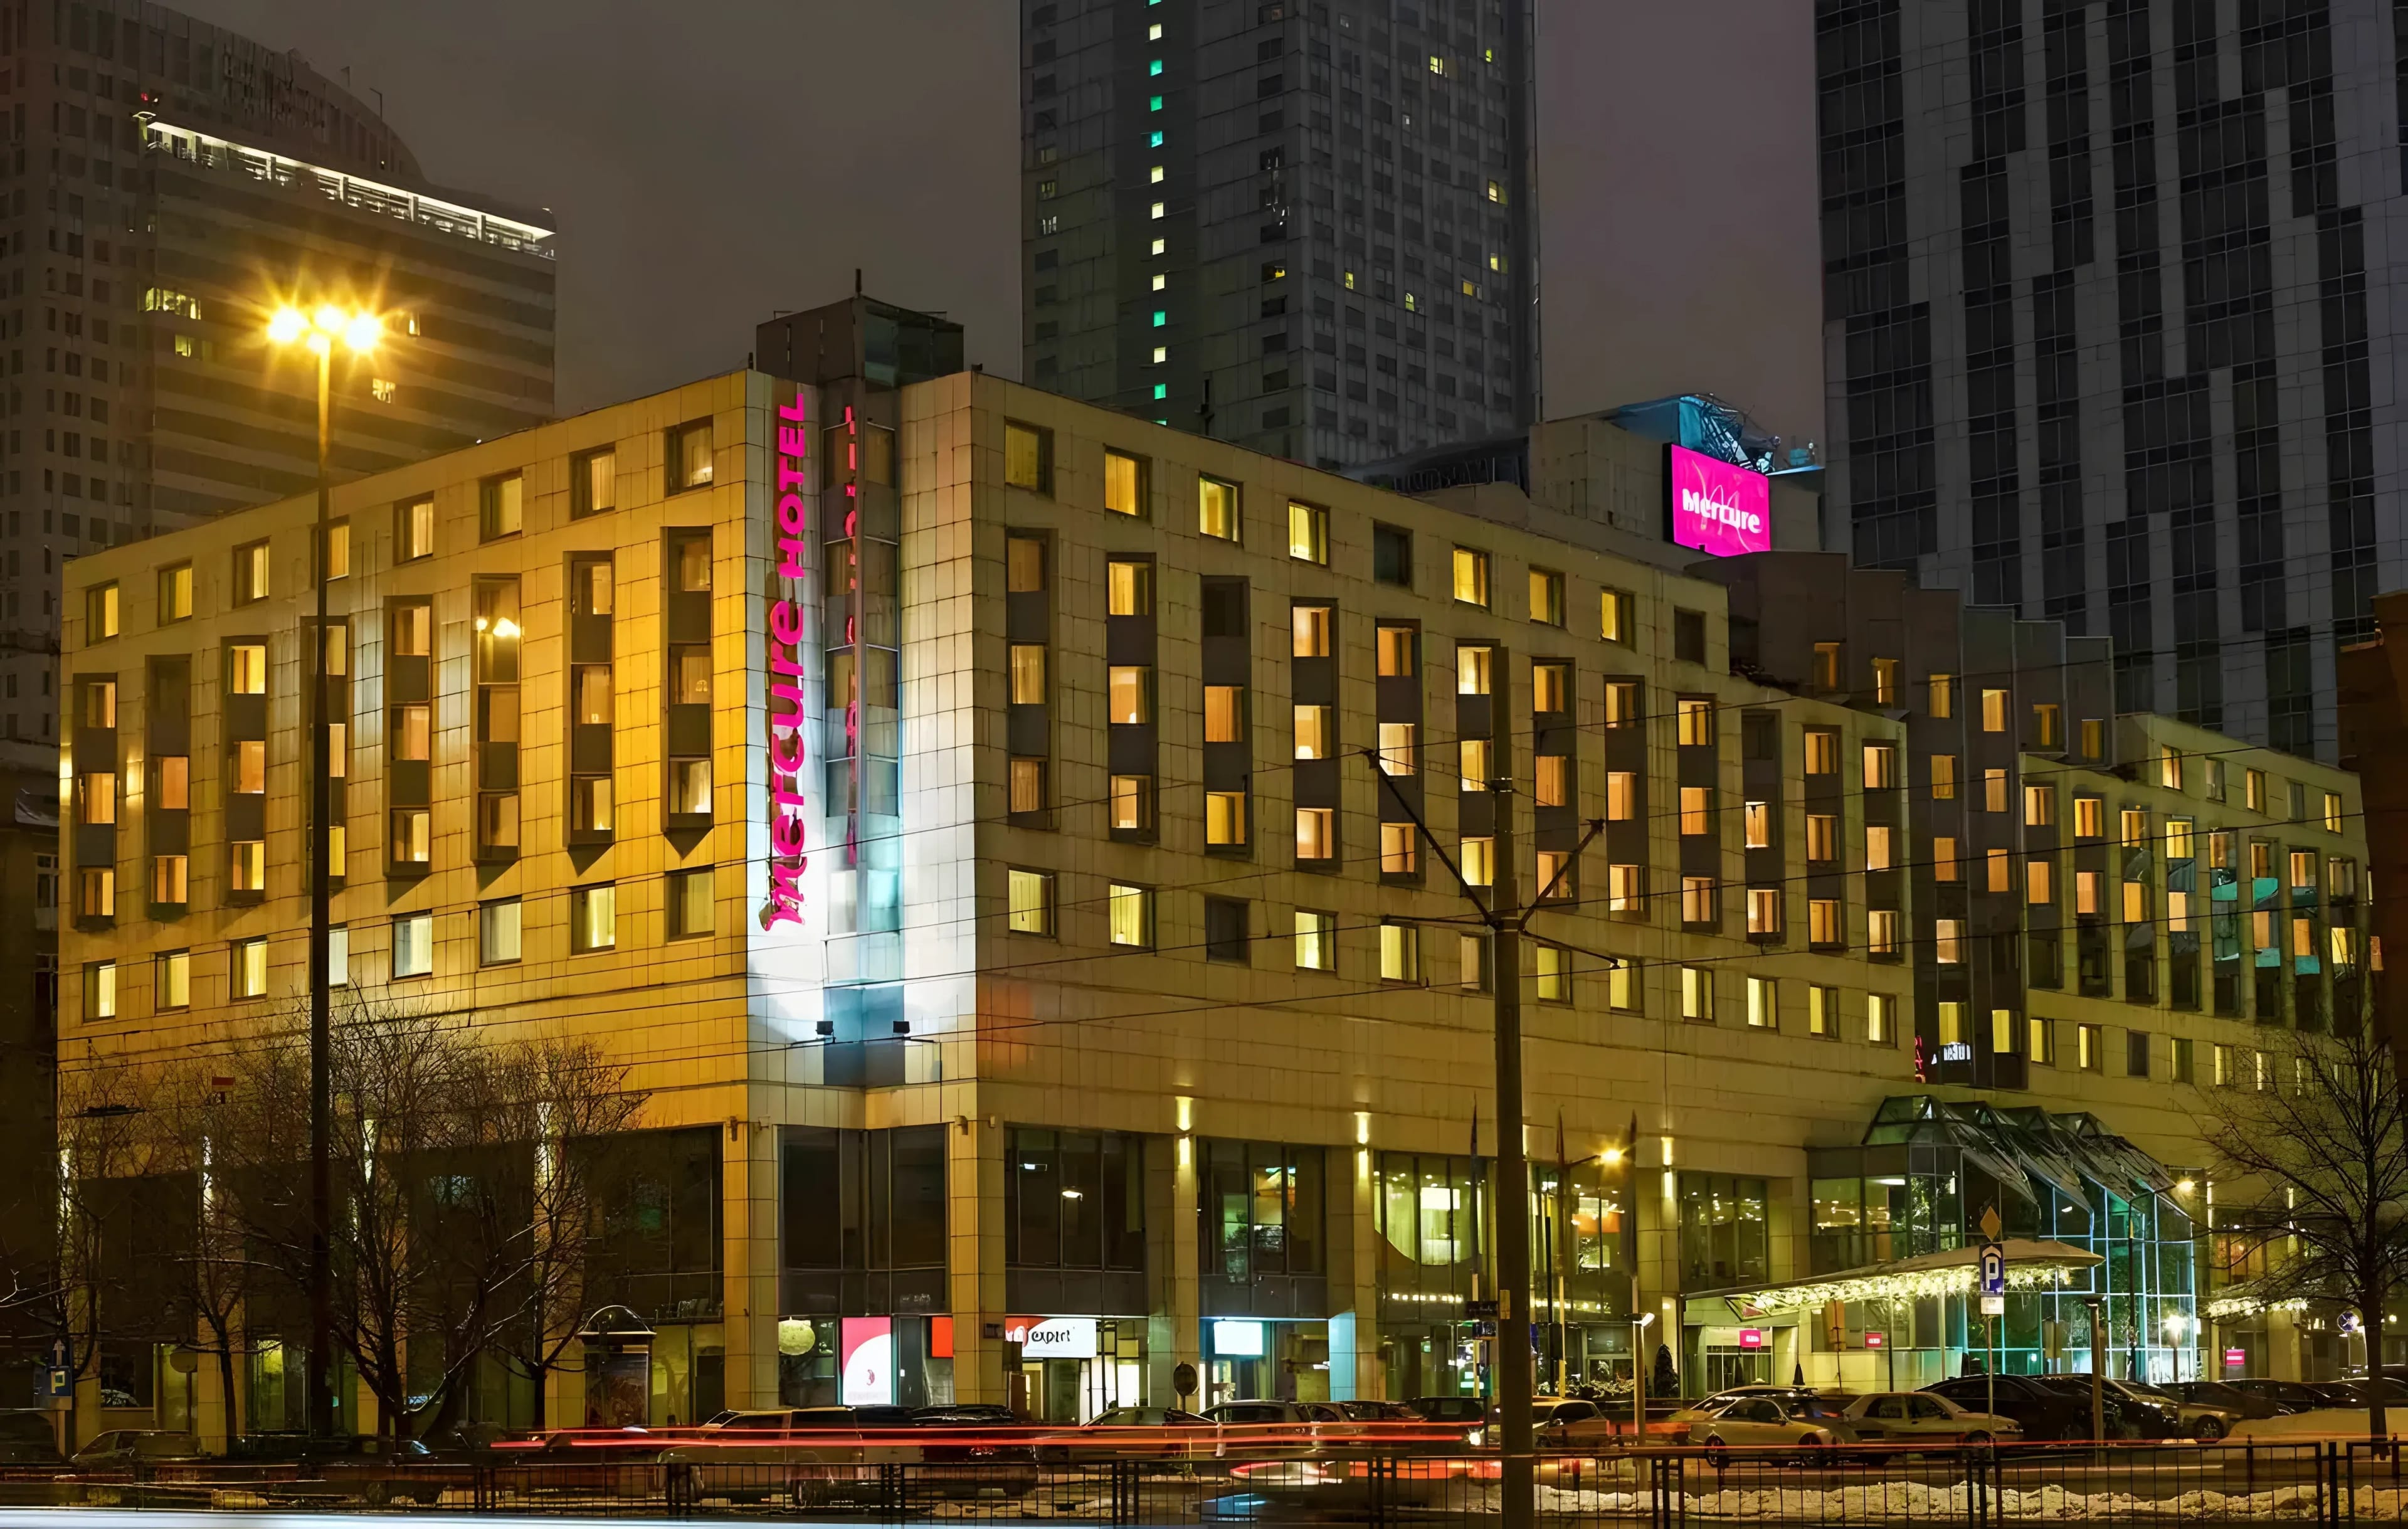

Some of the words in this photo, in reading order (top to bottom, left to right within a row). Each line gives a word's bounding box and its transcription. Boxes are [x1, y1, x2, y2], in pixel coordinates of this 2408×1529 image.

[778, 393, 805, 578] HOTEL
[1682, 488, 1762, 534] Mercure
[761, 600, 808, 932] Mercure
[1985, 1256, 1999, 1291] P
[51, 1370, 65, 1394] P
